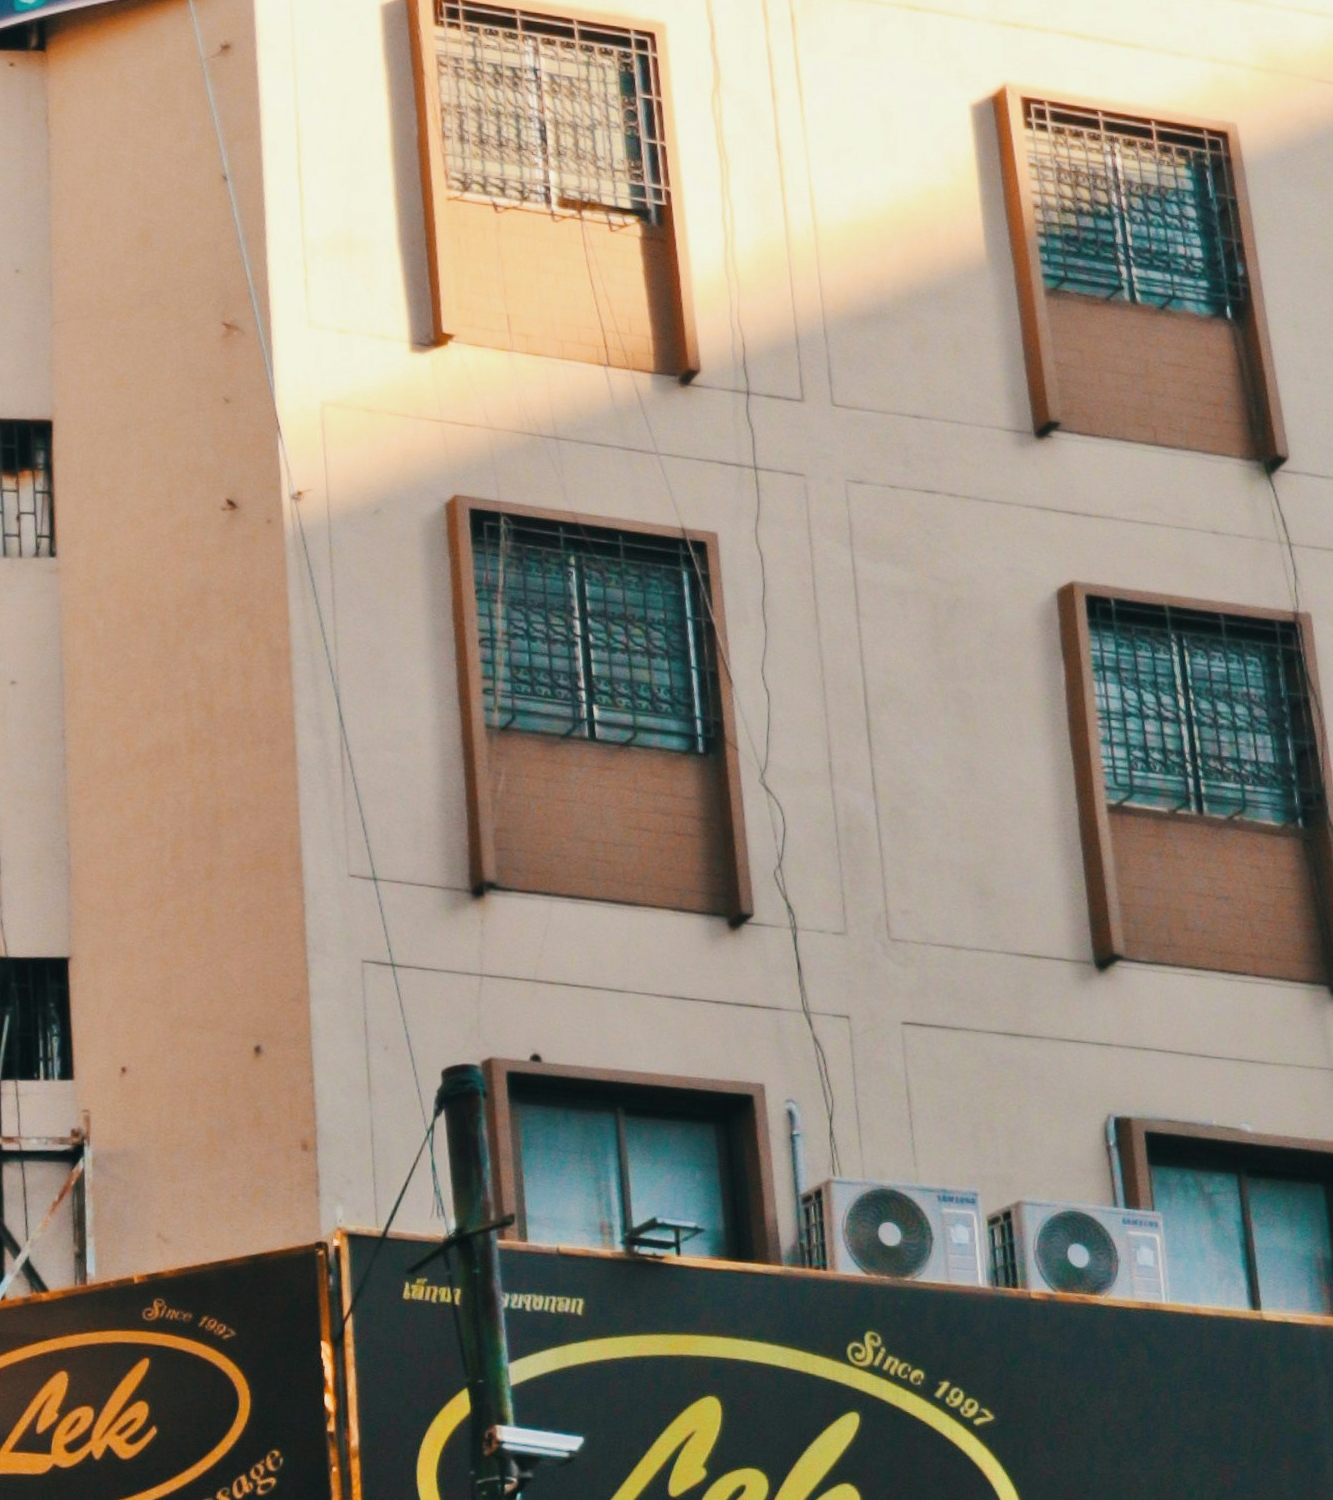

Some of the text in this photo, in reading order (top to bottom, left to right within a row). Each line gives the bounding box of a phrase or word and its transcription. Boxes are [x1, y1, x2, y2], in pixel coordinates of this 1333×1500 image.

[142, 1297, 238, 1342] Since 1997
[845, 1329, 997, 1429] Since 1997
